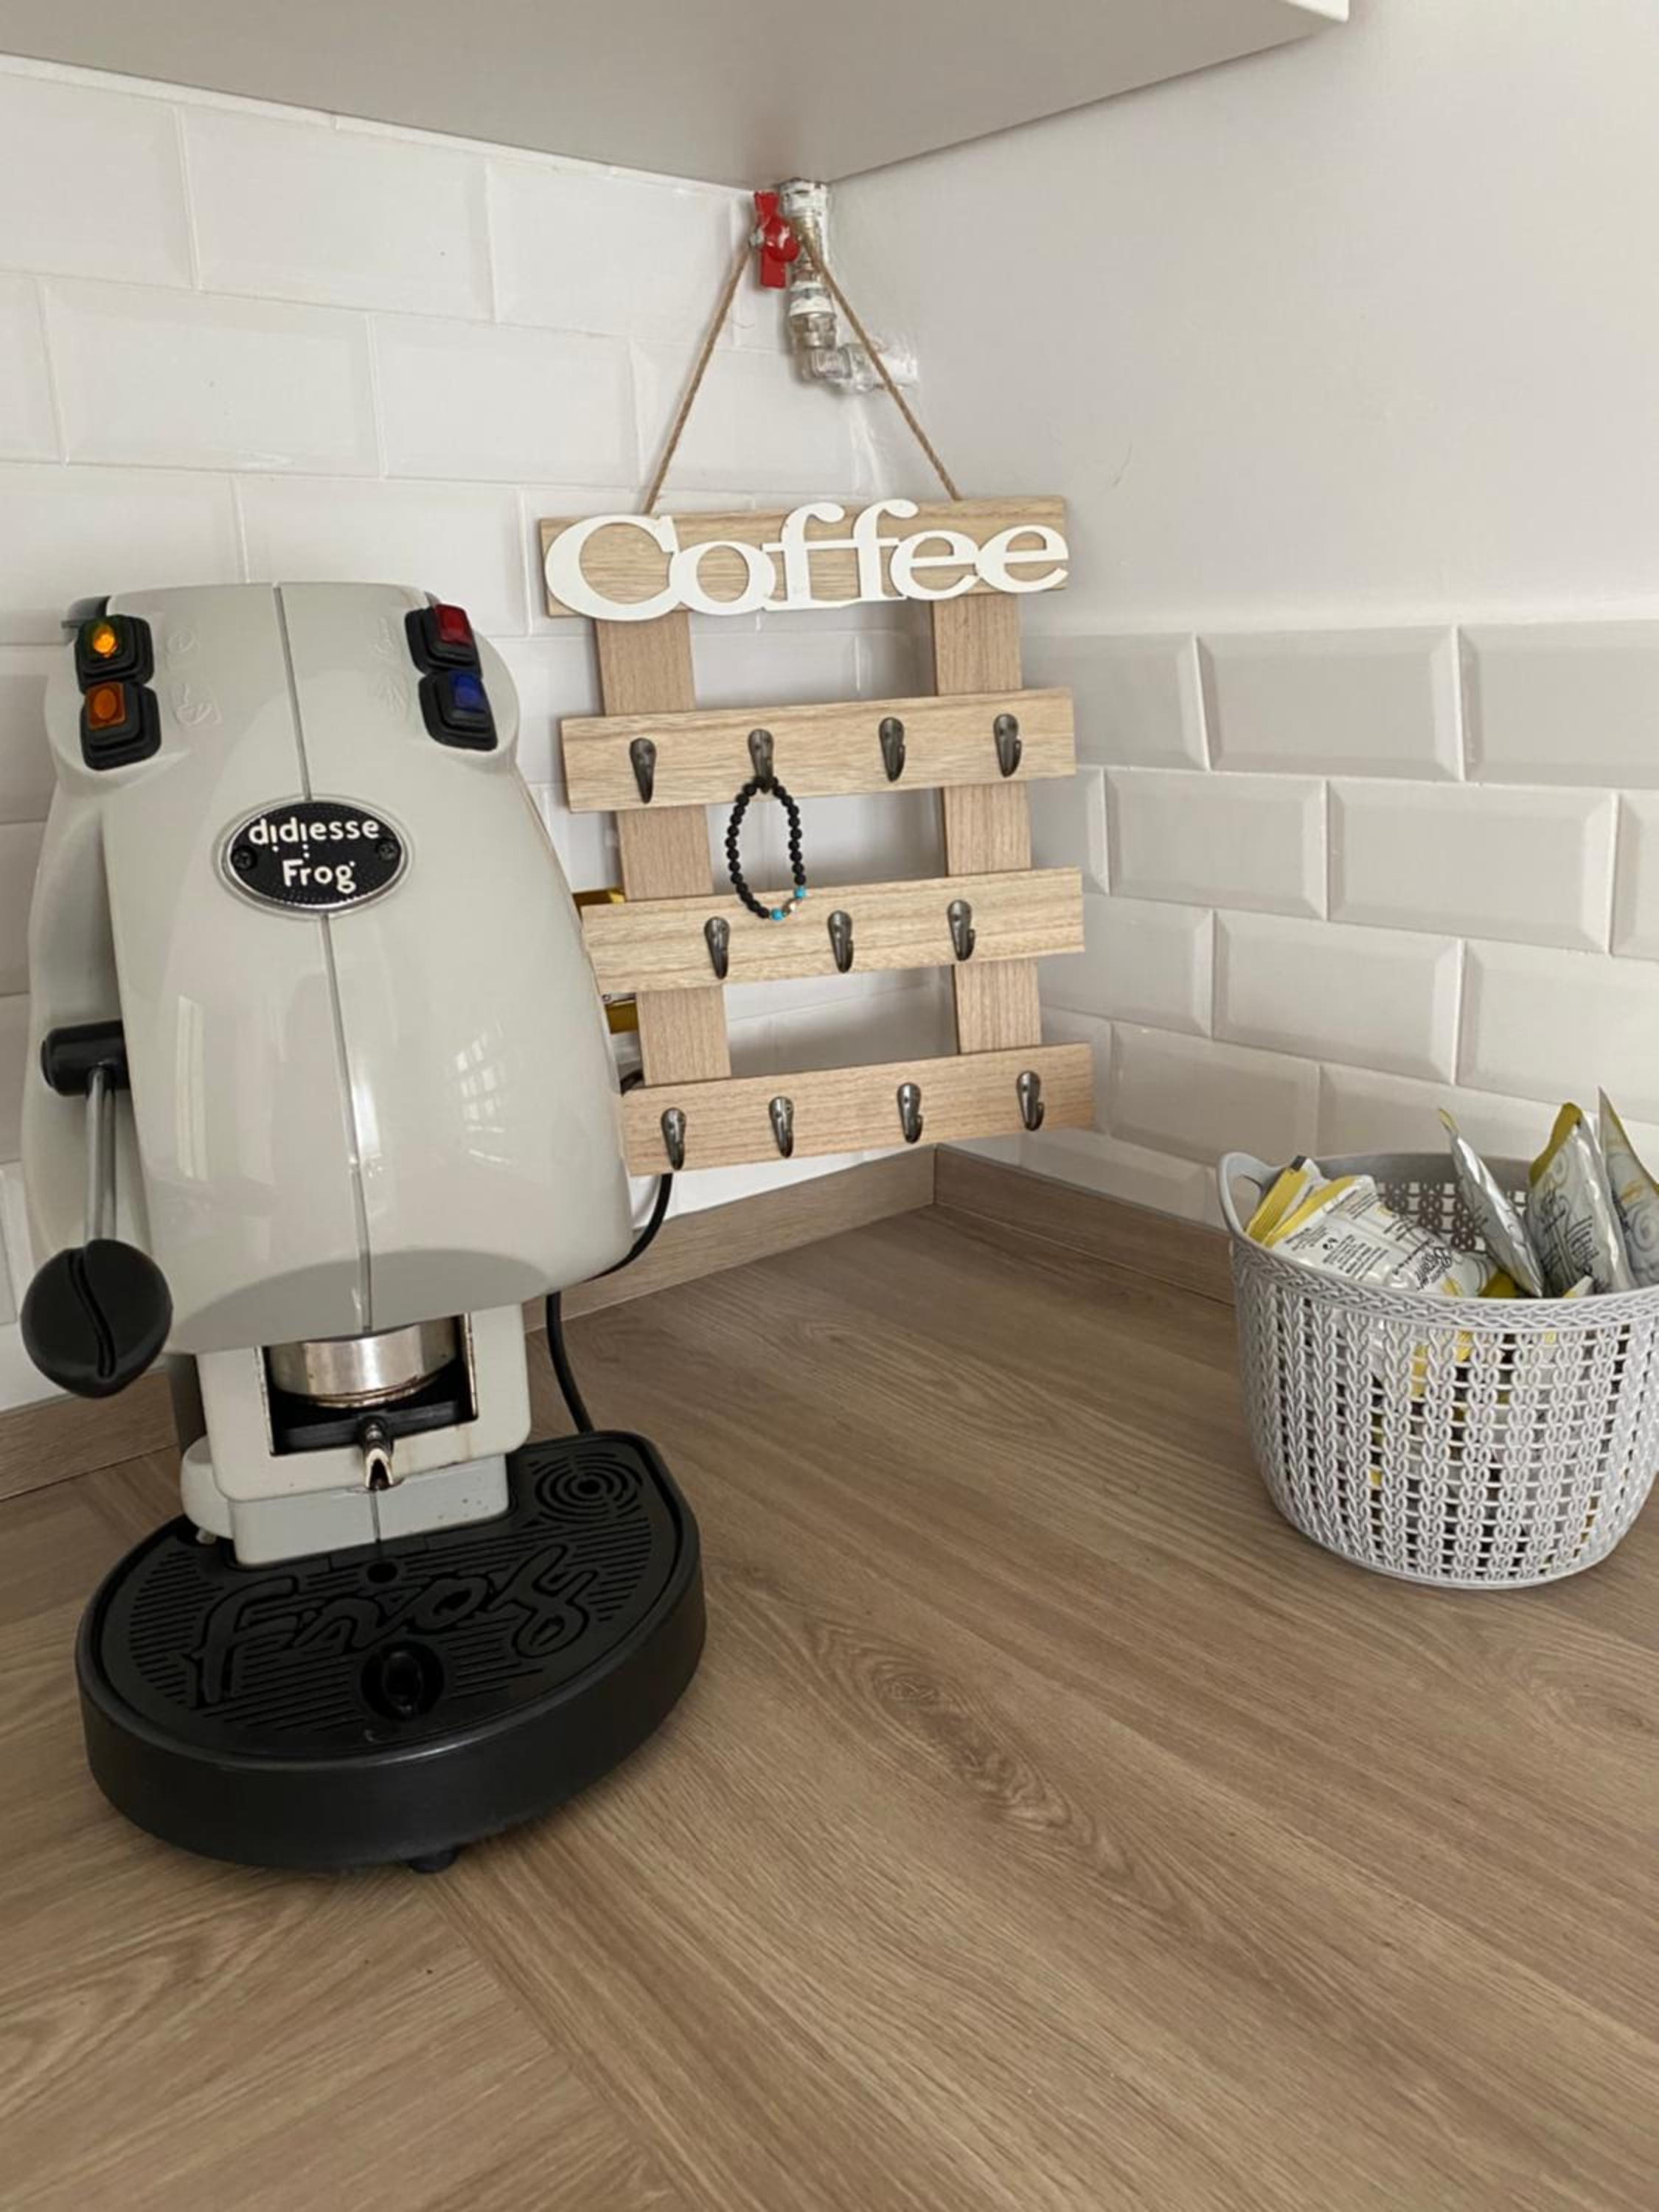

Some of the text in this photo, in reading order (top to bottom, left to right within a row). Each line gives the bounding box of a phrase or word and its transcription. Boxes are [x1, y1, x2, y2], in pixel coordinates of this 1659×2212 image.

[544, 499, 1068, 621] Coffee
[248, 817, 380, 854] didiesse
[283, 859, 357, 894] Frog
